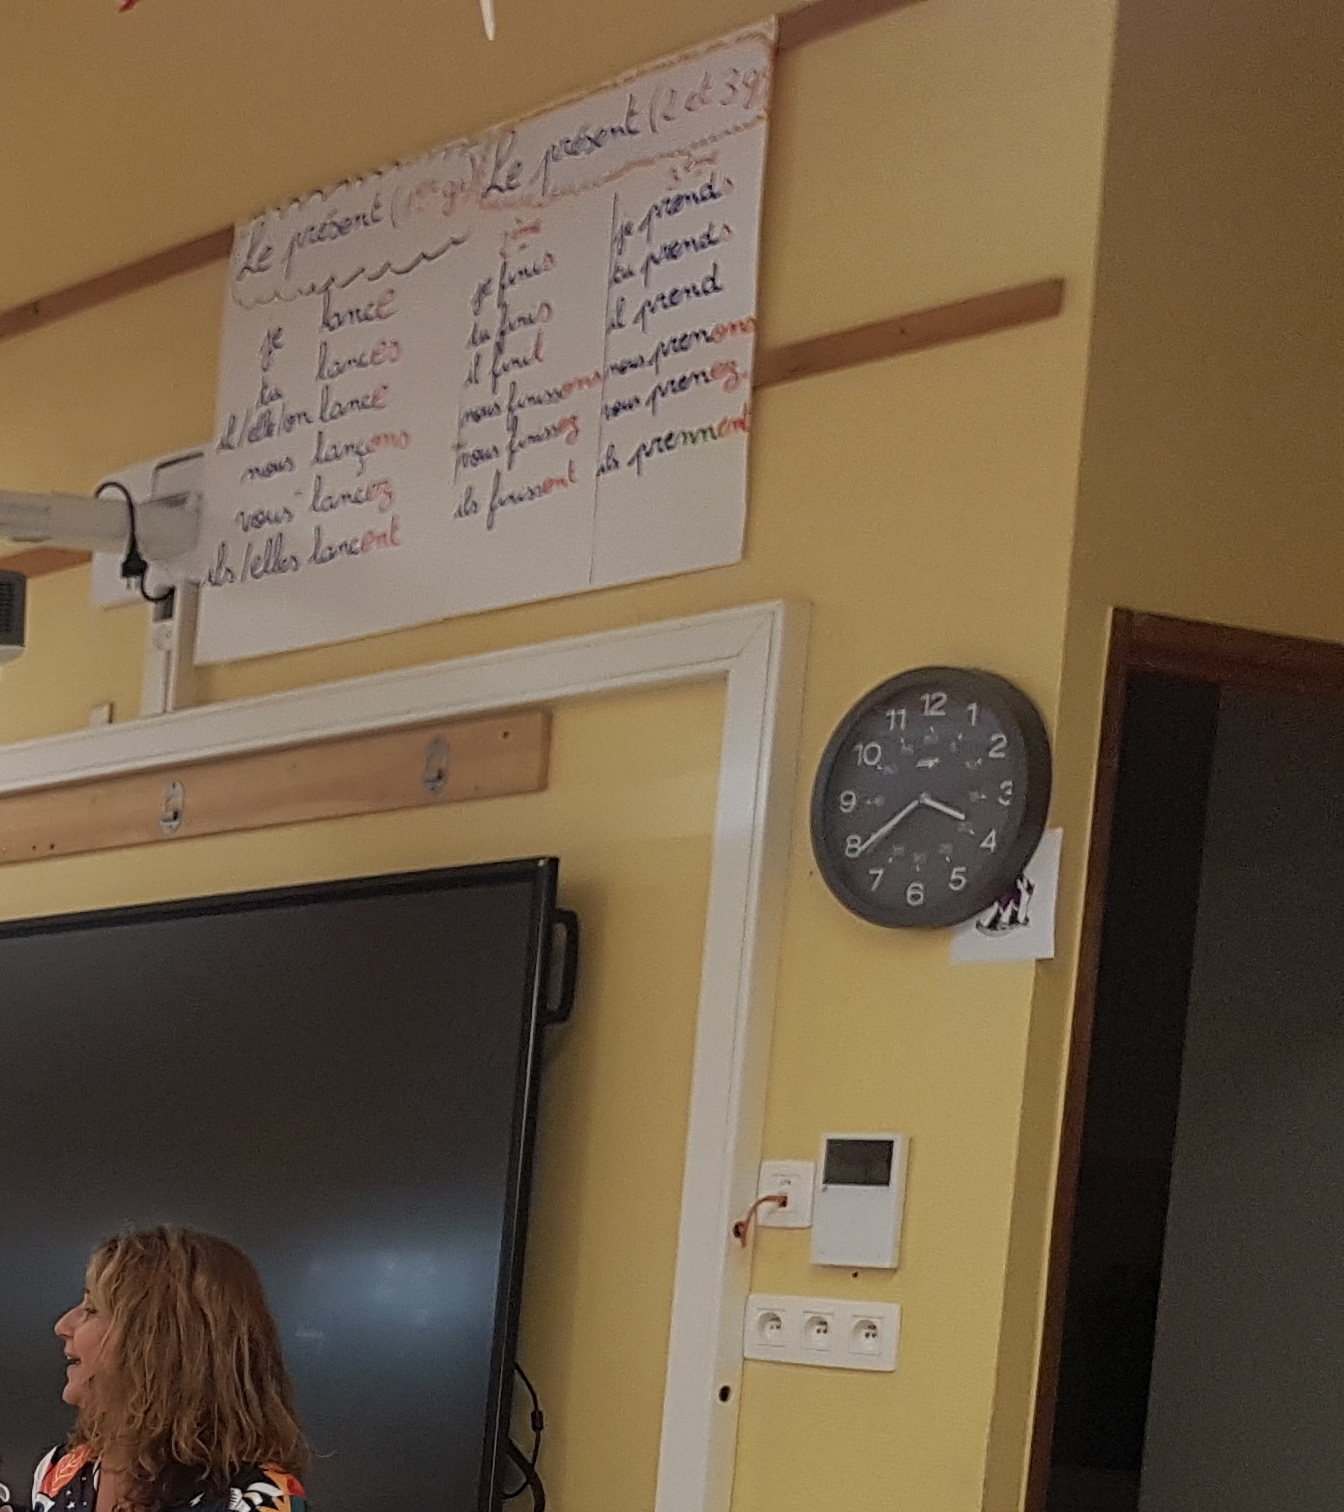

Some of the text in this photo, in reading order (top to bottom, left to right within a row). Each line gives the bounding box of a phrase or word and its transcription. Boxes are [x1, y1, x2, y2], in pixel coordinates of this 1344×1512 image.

[480, 131, 522, 198] Le
[531, 93, 640, 197] présent
[235, 220, 272, 281] Le
[283, 192, 382, 280] présent
[470, 276, 493, 316] je
[632, 262, 723, 334] prend
[260, 289, 399, 372] je lance
[465, 321, 492, 350] tu
[316, 340, 402, 381] lances
[464, 352, 482, 386] il
[318, 384, 390, 423] lance
[240, 429, 411, 485] nous lançons
[234, 475, 395, 533] vous lancez
[454, 485, 479, 519] ils
[308, 514, 402, 565] lancent
[920, 691, 947, 717] 12
[967, 702, 978, 726] 1
[885, 708, 907, 731] 11
[854, 740, 883, 766] 10
[988, 733, 1008, 758] 2
[839, 789, 858, 813] 9
[998, 780, 1014, 806] 3
[845, 834, 861, 858] 8
[979, 828, 997, 852] 4
[868, 867, 885, 892] 7
[948, 866, 968, 891] 5
[906, 881, 925, 907] 6
